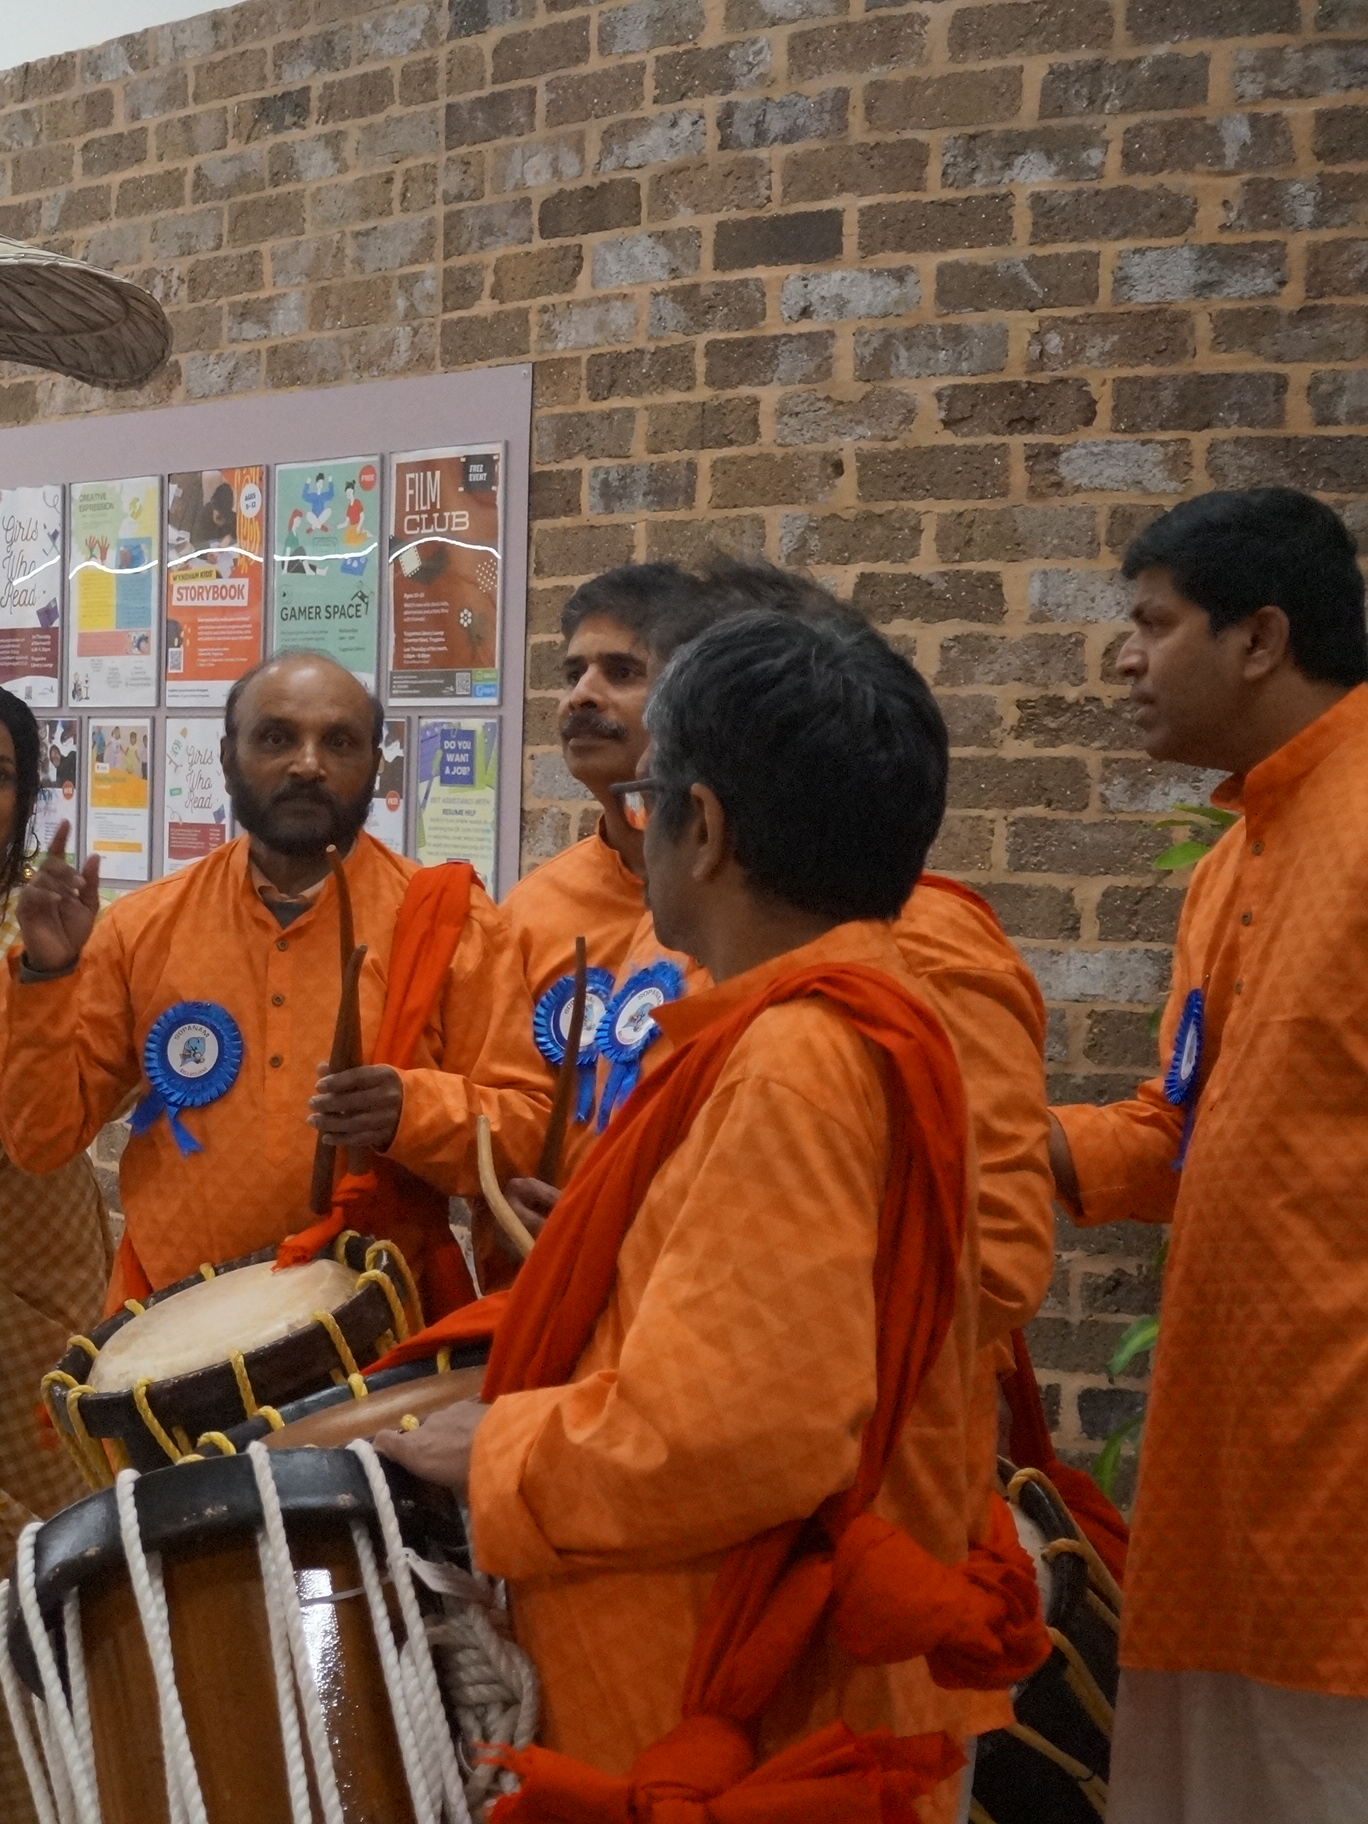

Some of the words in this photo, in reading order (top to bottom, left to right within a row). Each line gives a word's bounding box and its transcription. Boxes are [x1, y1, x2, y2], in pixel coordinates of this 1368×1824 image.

[468, 464, 484, 473] FREE
[468, 473, 488, 482] EVENT
[361, 474, 375, 482] FREE
[78, 492, 107, 502] CREATIVE
[405, 469, 440, 512] FILM
[78, 502, 114, 512] EXPRESSION
[403, 510, 470, 535] CLUB
[1, 515, 38, 553] Girls
[2, 549, 37, 583] Who
[0, 581, 37, 615] Read
[176, 584, 246, 602] STORYBOOK
[280, 605, 322, 621] GAMER
[324, 603, 362, 620] SPACE
[443, 741, 456, 750] DO
[457, 741, 471, 750] YOU
[186, 745, 213, 771] Girls
[446, 753, 469, 763] WANT
[444, 767, 450, 775] A
[451, 767, 471, 776] JOB?
[185, 769, 212, 793] Who
[184, 790, 213, 814] Read
[173, 1024, 211, 1041] SOPANAM
